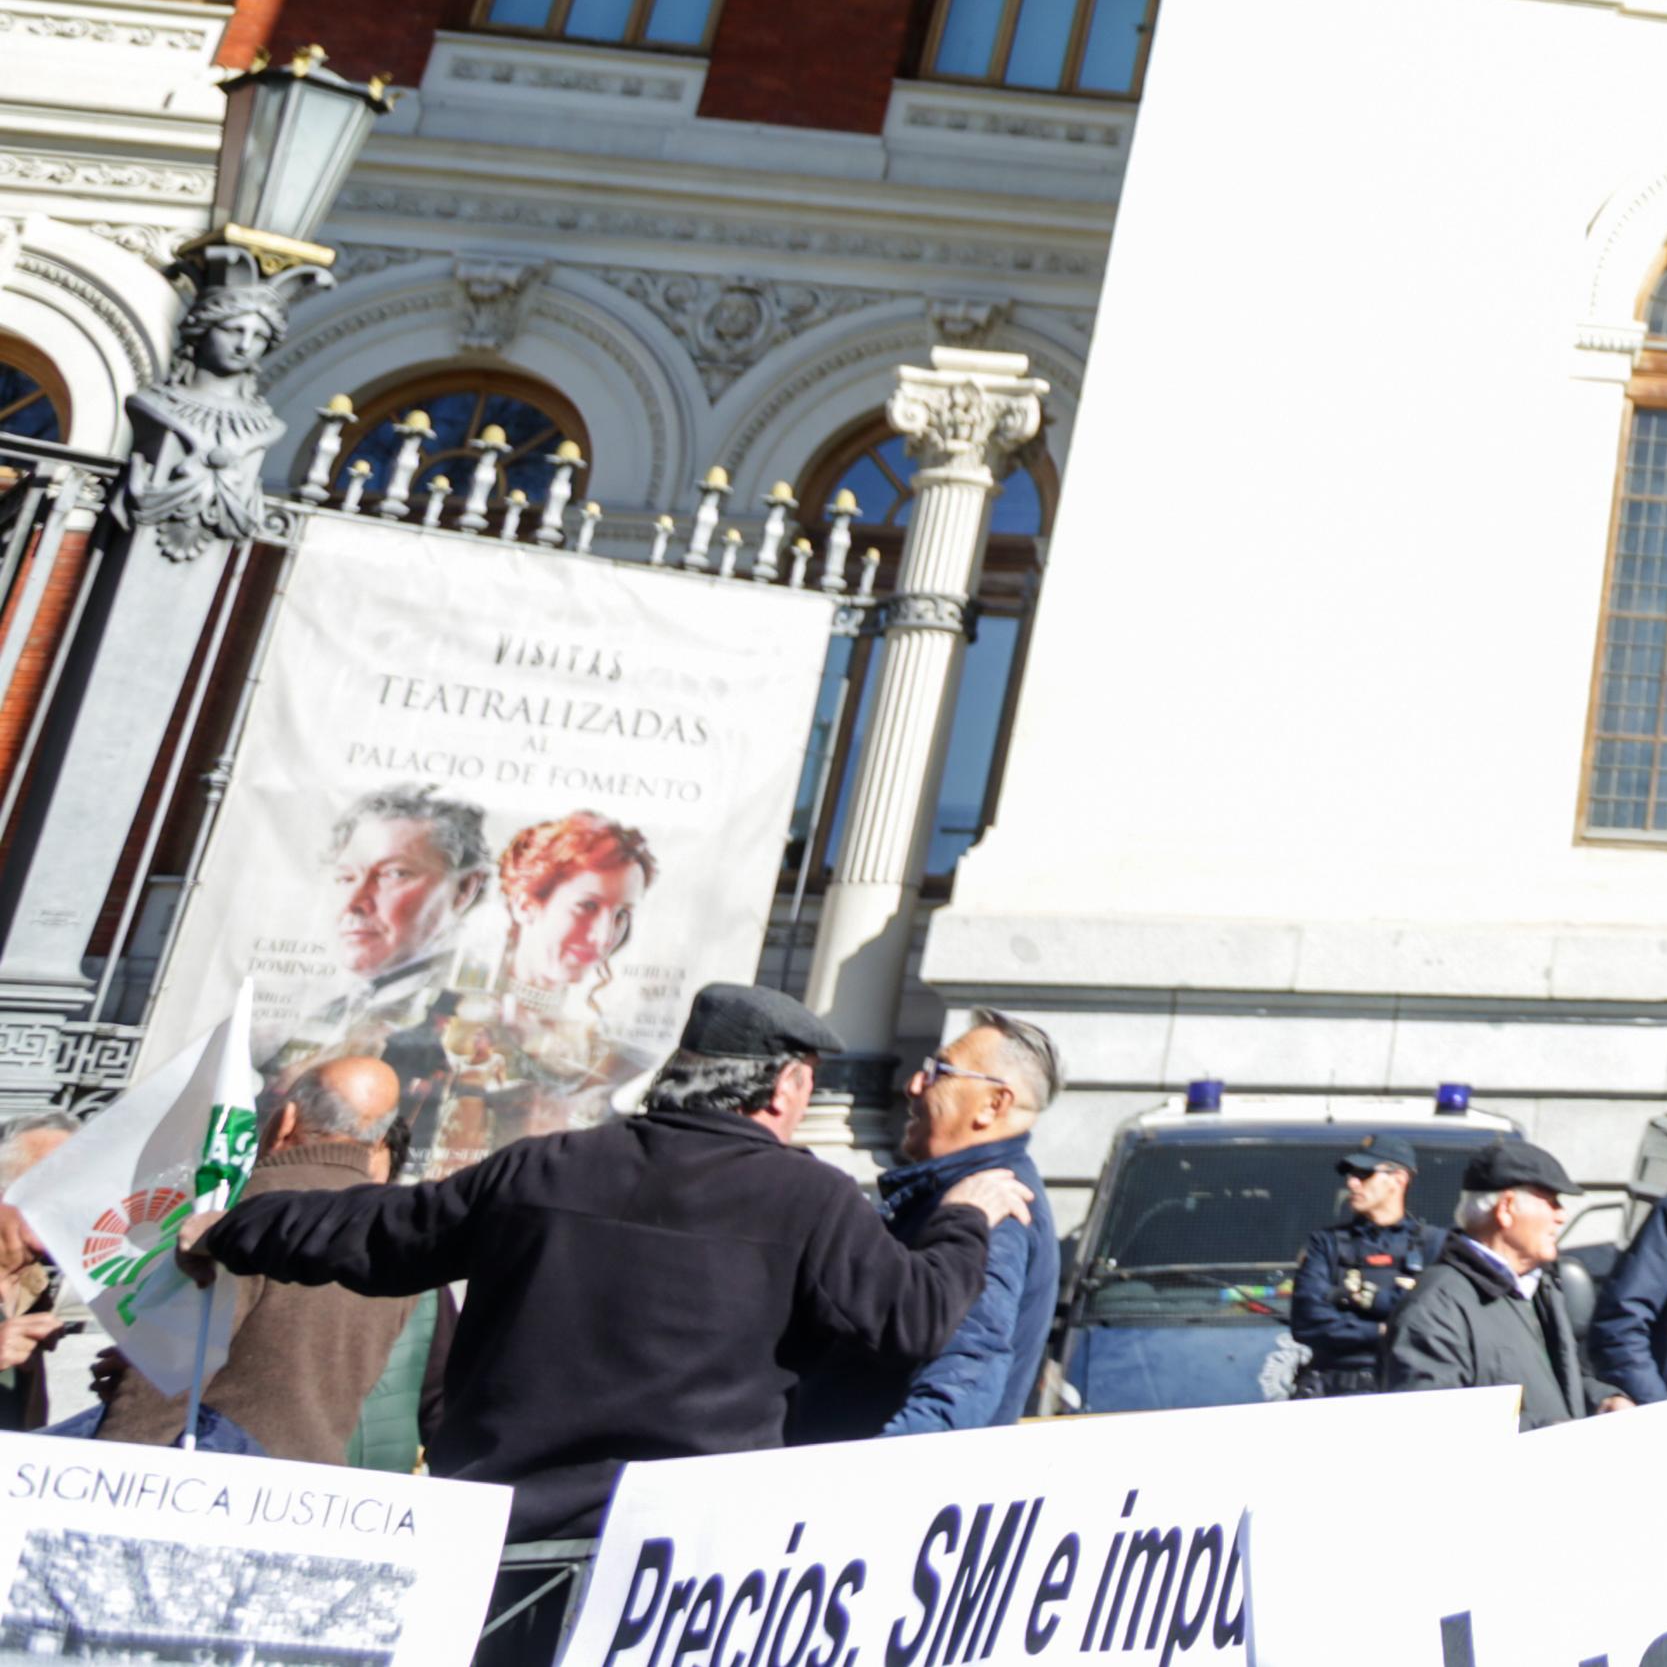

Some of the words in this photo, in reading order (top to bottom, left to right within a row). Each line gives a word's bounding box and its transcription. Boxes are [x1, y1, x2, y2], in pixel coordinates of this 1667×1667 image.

[495, 633, 623, 682] VISITAS
[378, 673, 708, 746] TEATRALIZADAS
[346, 742, 485, 780] PALACIO
[495, 759, 538, 786] DE
[548, 764, 702, 803] FOMENTO
[523, 736, 549, 754] AL
[248, 956, 337, 977] DOMINGO
[8, 1463, 231, 1517] SIGNIFICA
[245, 1486, 417, 1537] JUSTICIA
[884, 1497, 1046, 1667] SMI
[1023, 1531, 1081, 1656] e
